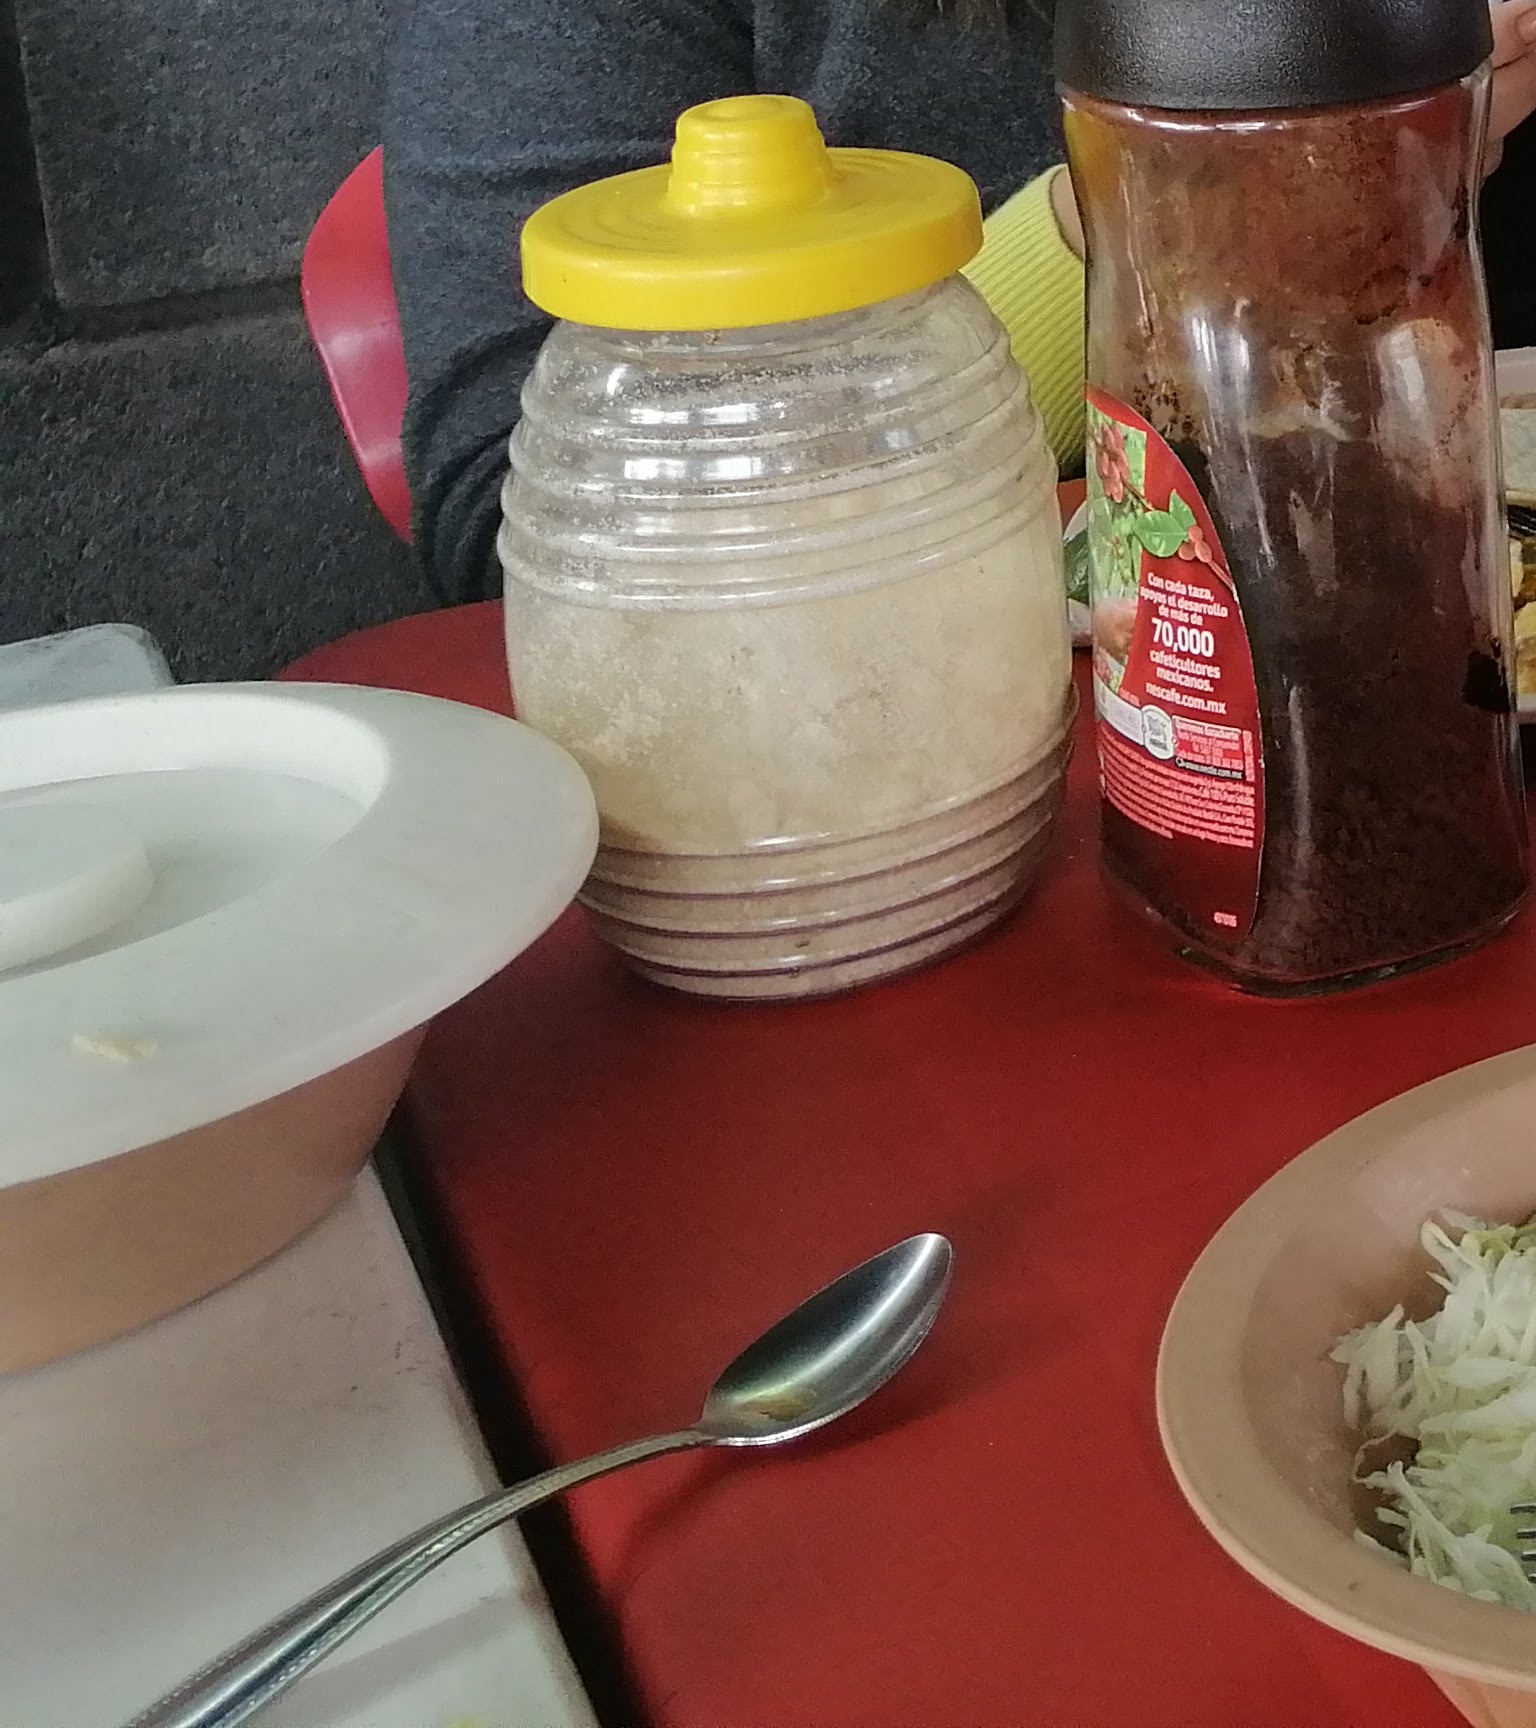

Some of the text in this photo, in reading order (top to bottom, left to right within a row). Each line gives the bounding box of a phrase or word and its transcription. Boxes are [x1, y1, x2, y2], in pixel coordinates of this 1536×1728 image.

[1140, 586, 1228, 617] apoyas el desarrollo
[1147, 572, 1215, 602] Con cada taza,
[1158, 605, 1169, 617] de
[1190, 612, 1203, 626] de
[1151, 617, 1215, 657] 70,000
[1149, 650, 1221, 679] cafeticultores
[1156, 666, 1214, 693] mexicanos.
[1145, 682, 1227, 715] nescafe.com.mx
